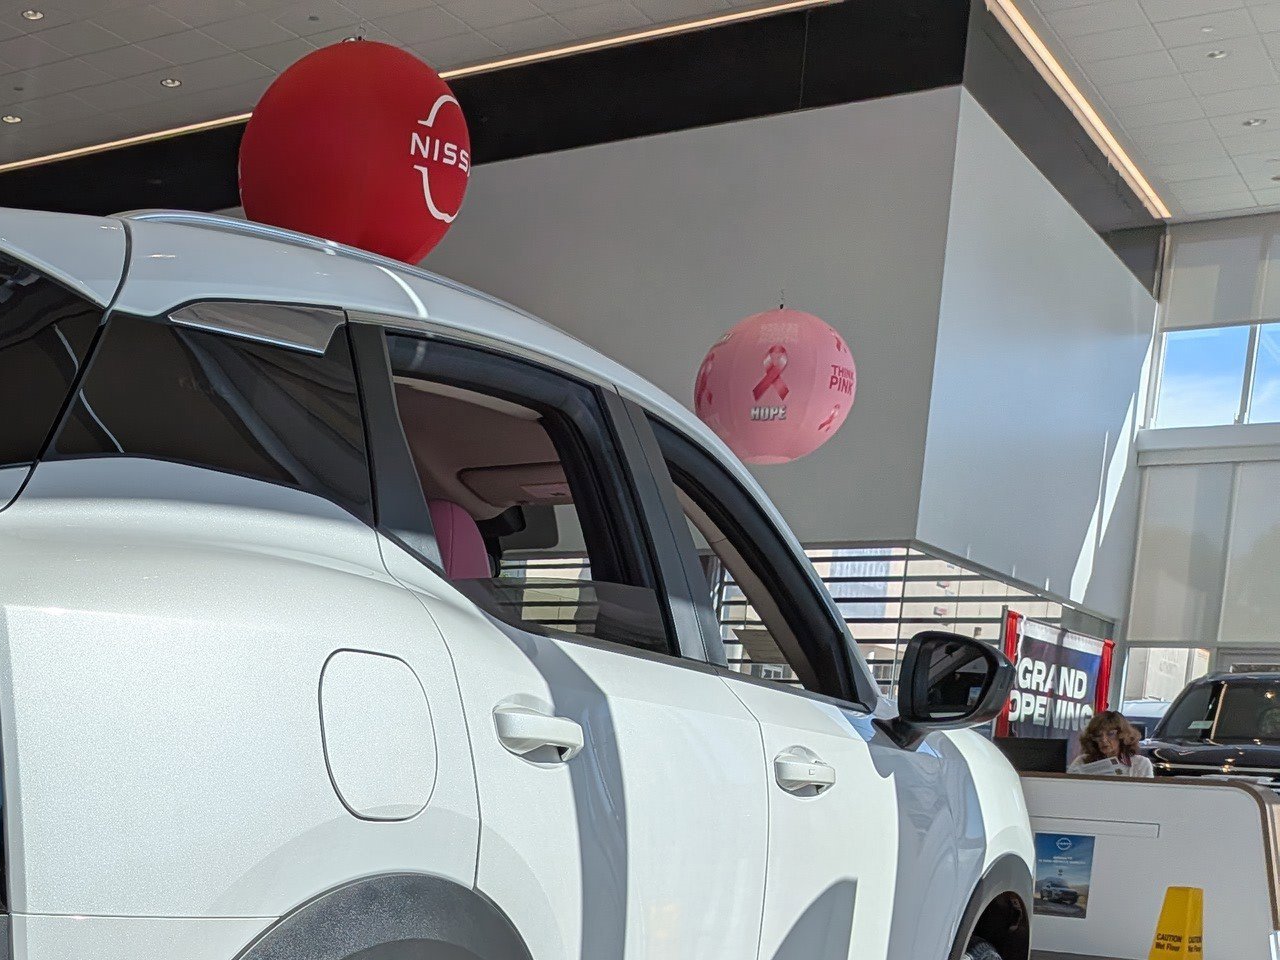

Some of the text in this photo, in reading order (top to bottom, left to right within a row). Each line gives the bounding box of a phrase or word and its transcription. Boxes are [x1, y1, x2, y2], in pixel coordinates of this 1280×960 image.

[410, 132, 471, 178] NISS
[831, 364, 854, 380] THINK
[829, 375, 854, 396] PINK
[750, 405, 787, 421] HOPE
[1018, 657, 1088, 700] GRAND
[1008, 689, 1094, 732] OPENING
[1156, 932, 1183, 943] CAUTION
[1166, 943, 1180, 951] Floor
